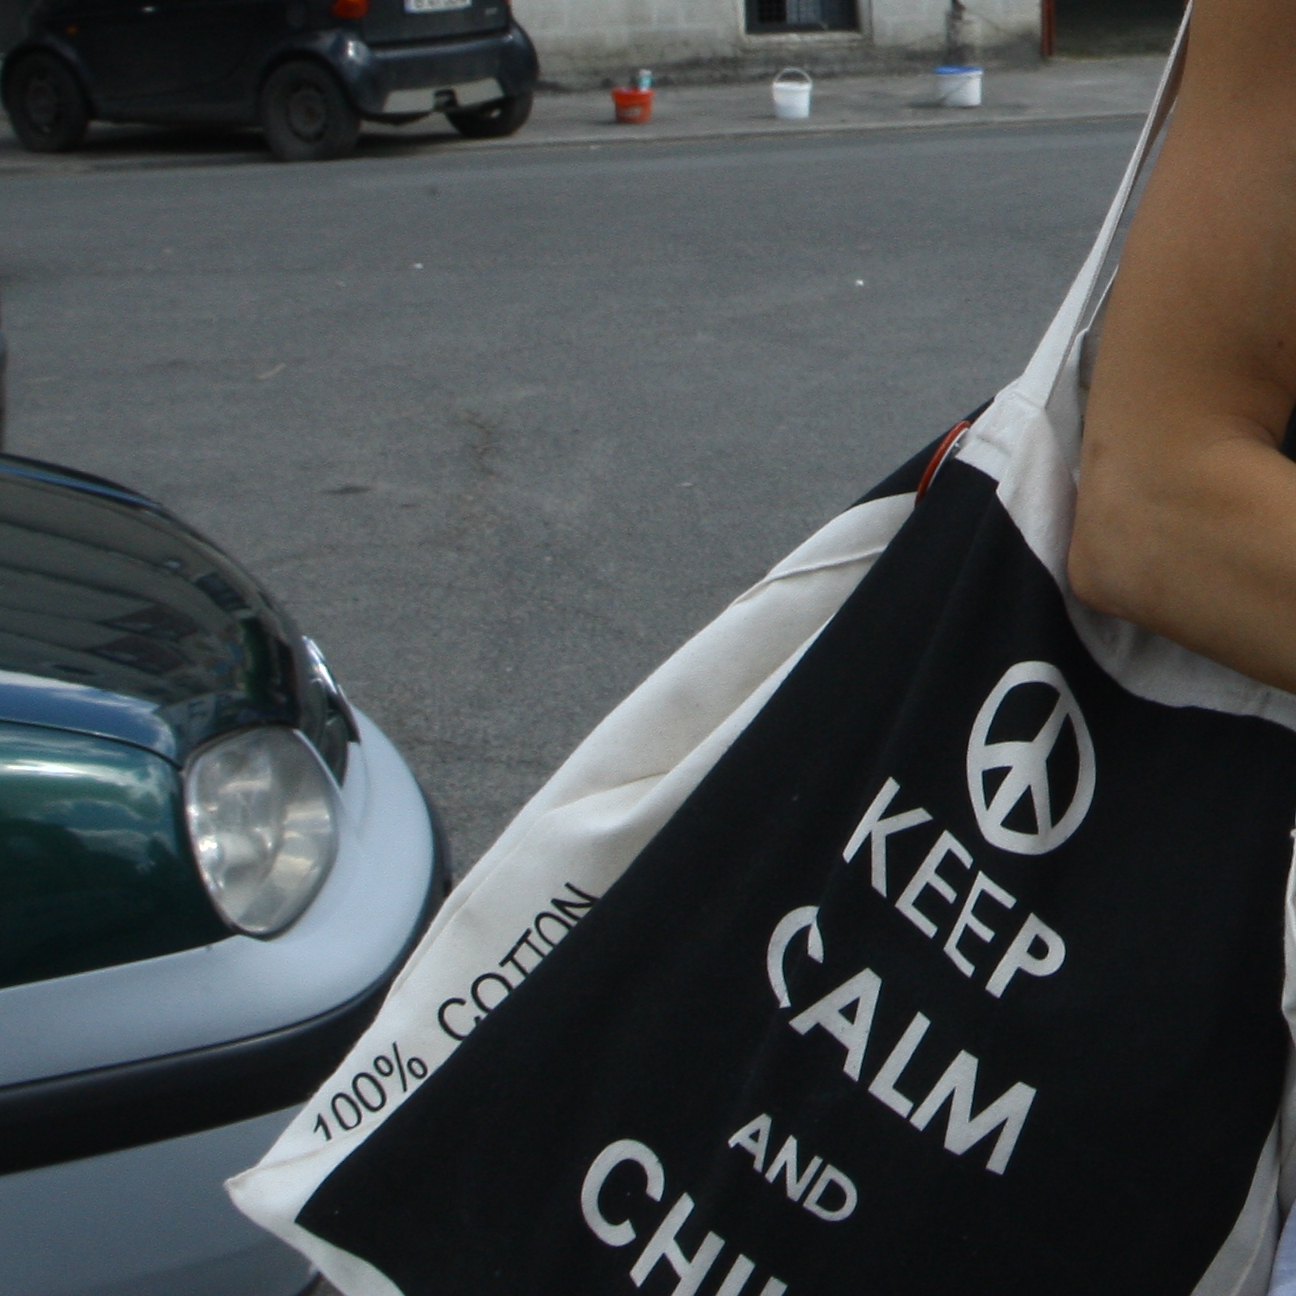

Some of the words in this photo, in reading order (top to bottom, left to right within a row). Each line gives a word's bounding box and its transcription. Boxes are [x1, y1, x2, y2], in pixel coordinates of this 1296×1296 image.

[842, 776, 1067, 999] KEEP
[313, 1041, 428, 1142] 100%
[437, 882, 600, 1042] COTTON
[767, 905, 1037, 1175] CALM
[728, 1113, 858, 1222] AND
